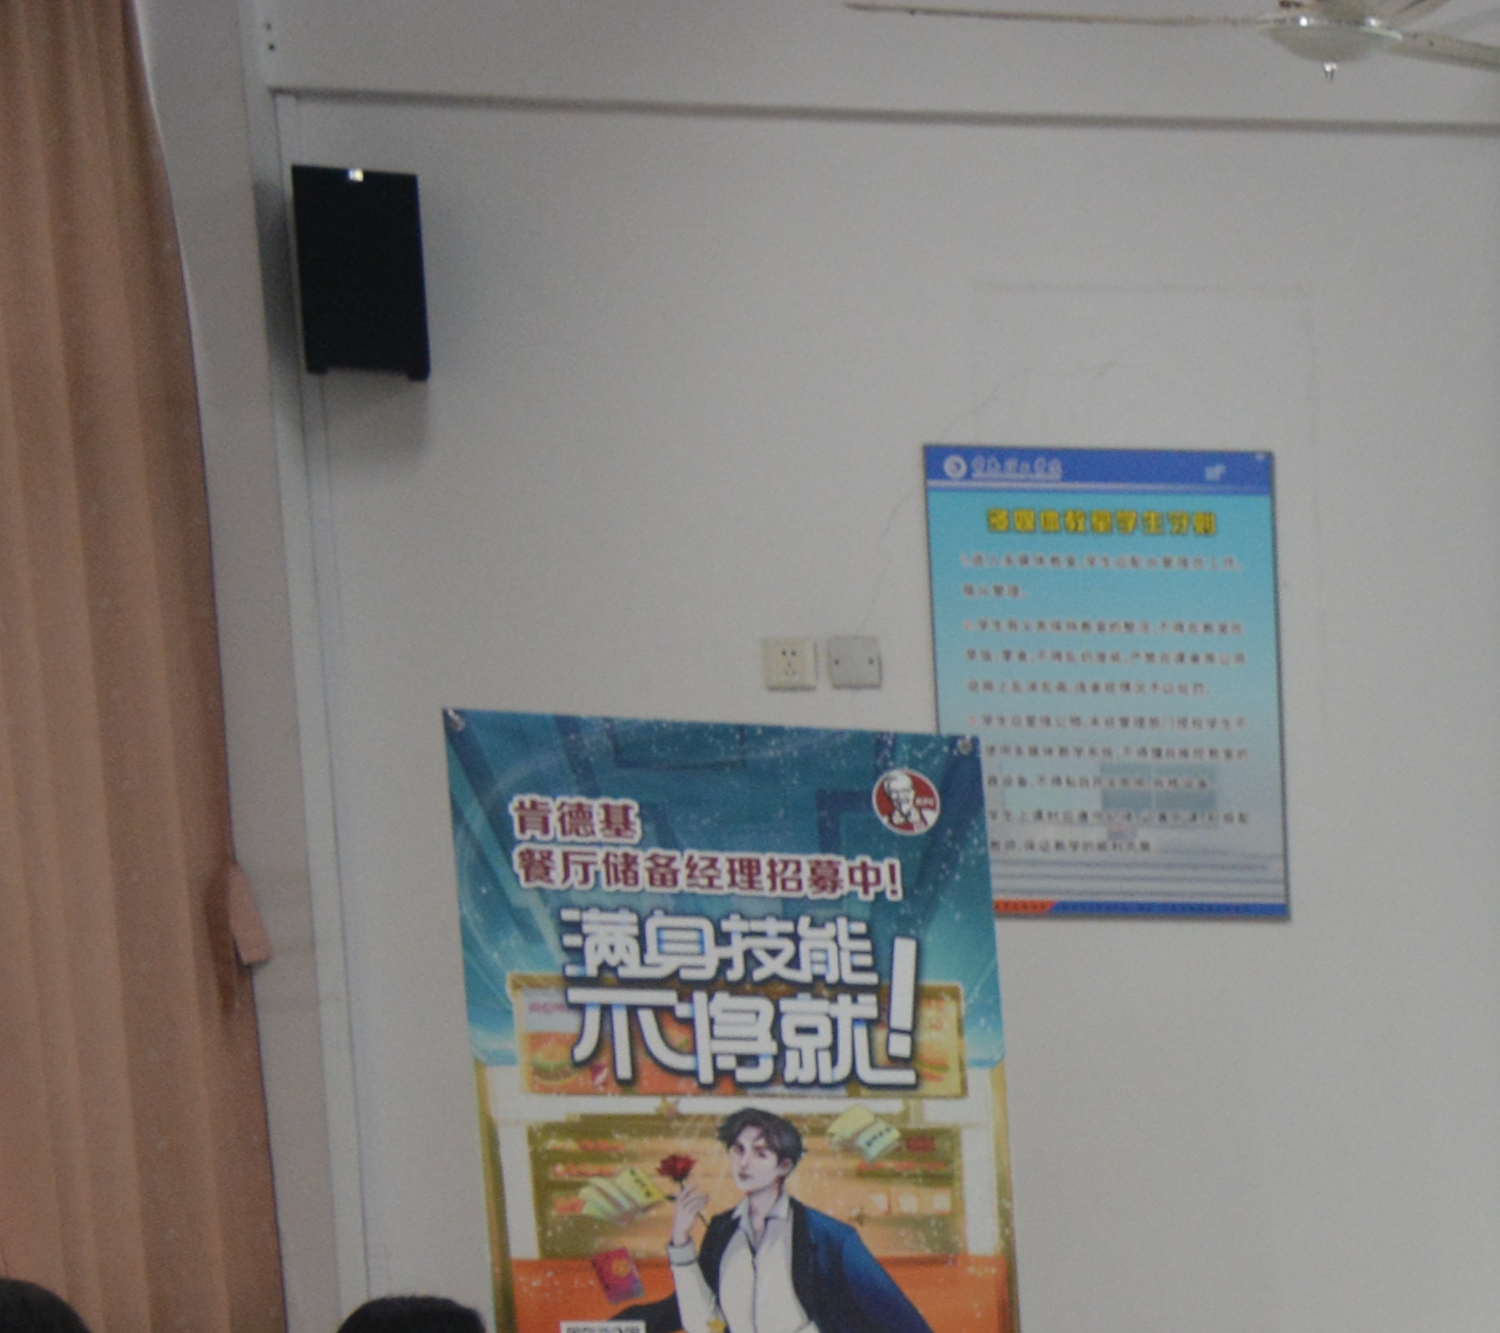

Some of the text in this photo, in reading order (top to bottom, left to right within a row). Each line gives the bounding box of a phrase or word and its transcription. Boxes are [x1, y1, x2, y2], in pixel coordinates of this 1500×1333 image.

[510, 796, 640, 842] 肯德基
[560, 906, 880, 987] 满身技能
